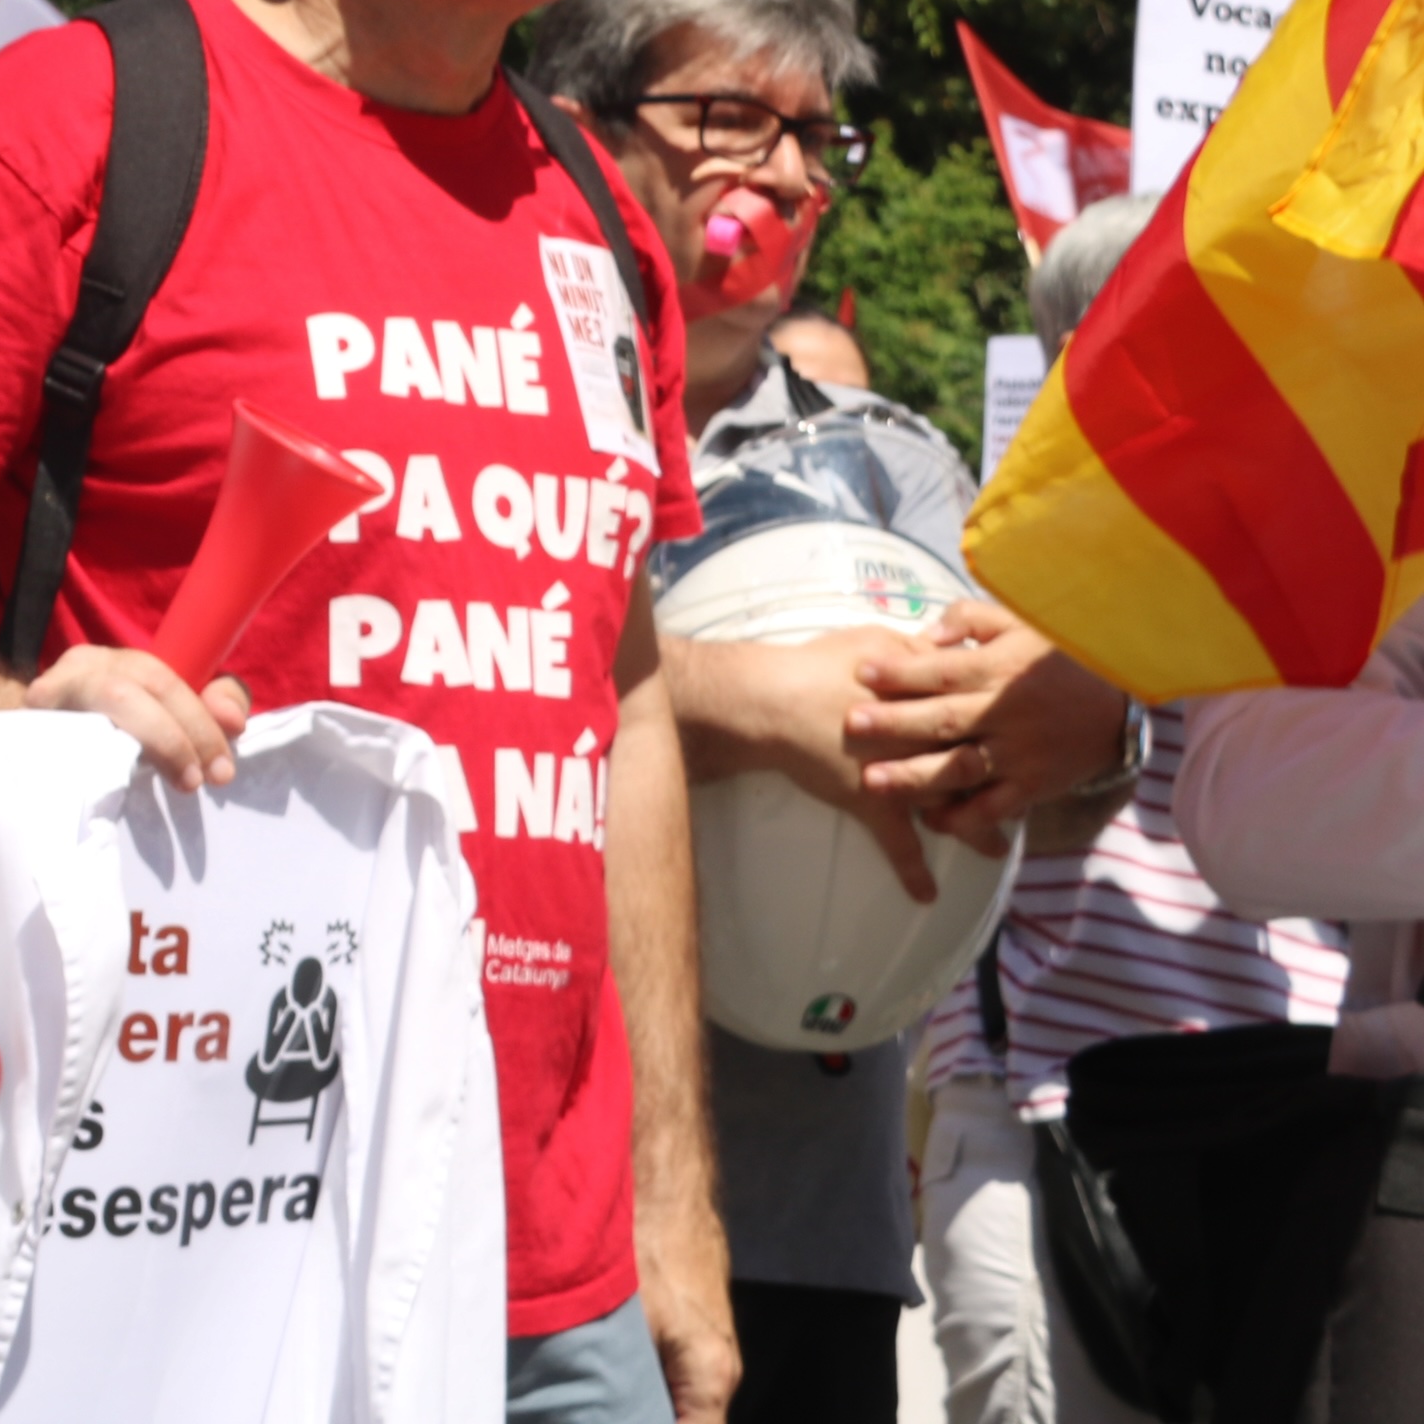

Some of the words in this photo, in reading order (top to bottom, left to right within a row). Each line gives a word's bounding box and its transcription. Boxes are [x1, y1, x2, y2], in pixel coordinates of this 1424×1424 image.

[305, 302, 550, 417] PANÉ
[327, 447, 463, 544] PA
[471, 455, 654, 581] QUÉ?
[328, 579, 573, 700] PANÉ
[434, 743, 479, 833] A
[493, 726, 607, 853] NÁ!
[126, 910, 190, 976] ta
[486, 933, 551, 964] Metges
[117, 1011, 231, 1064] era
[70, 1098, 105, 1151] s
